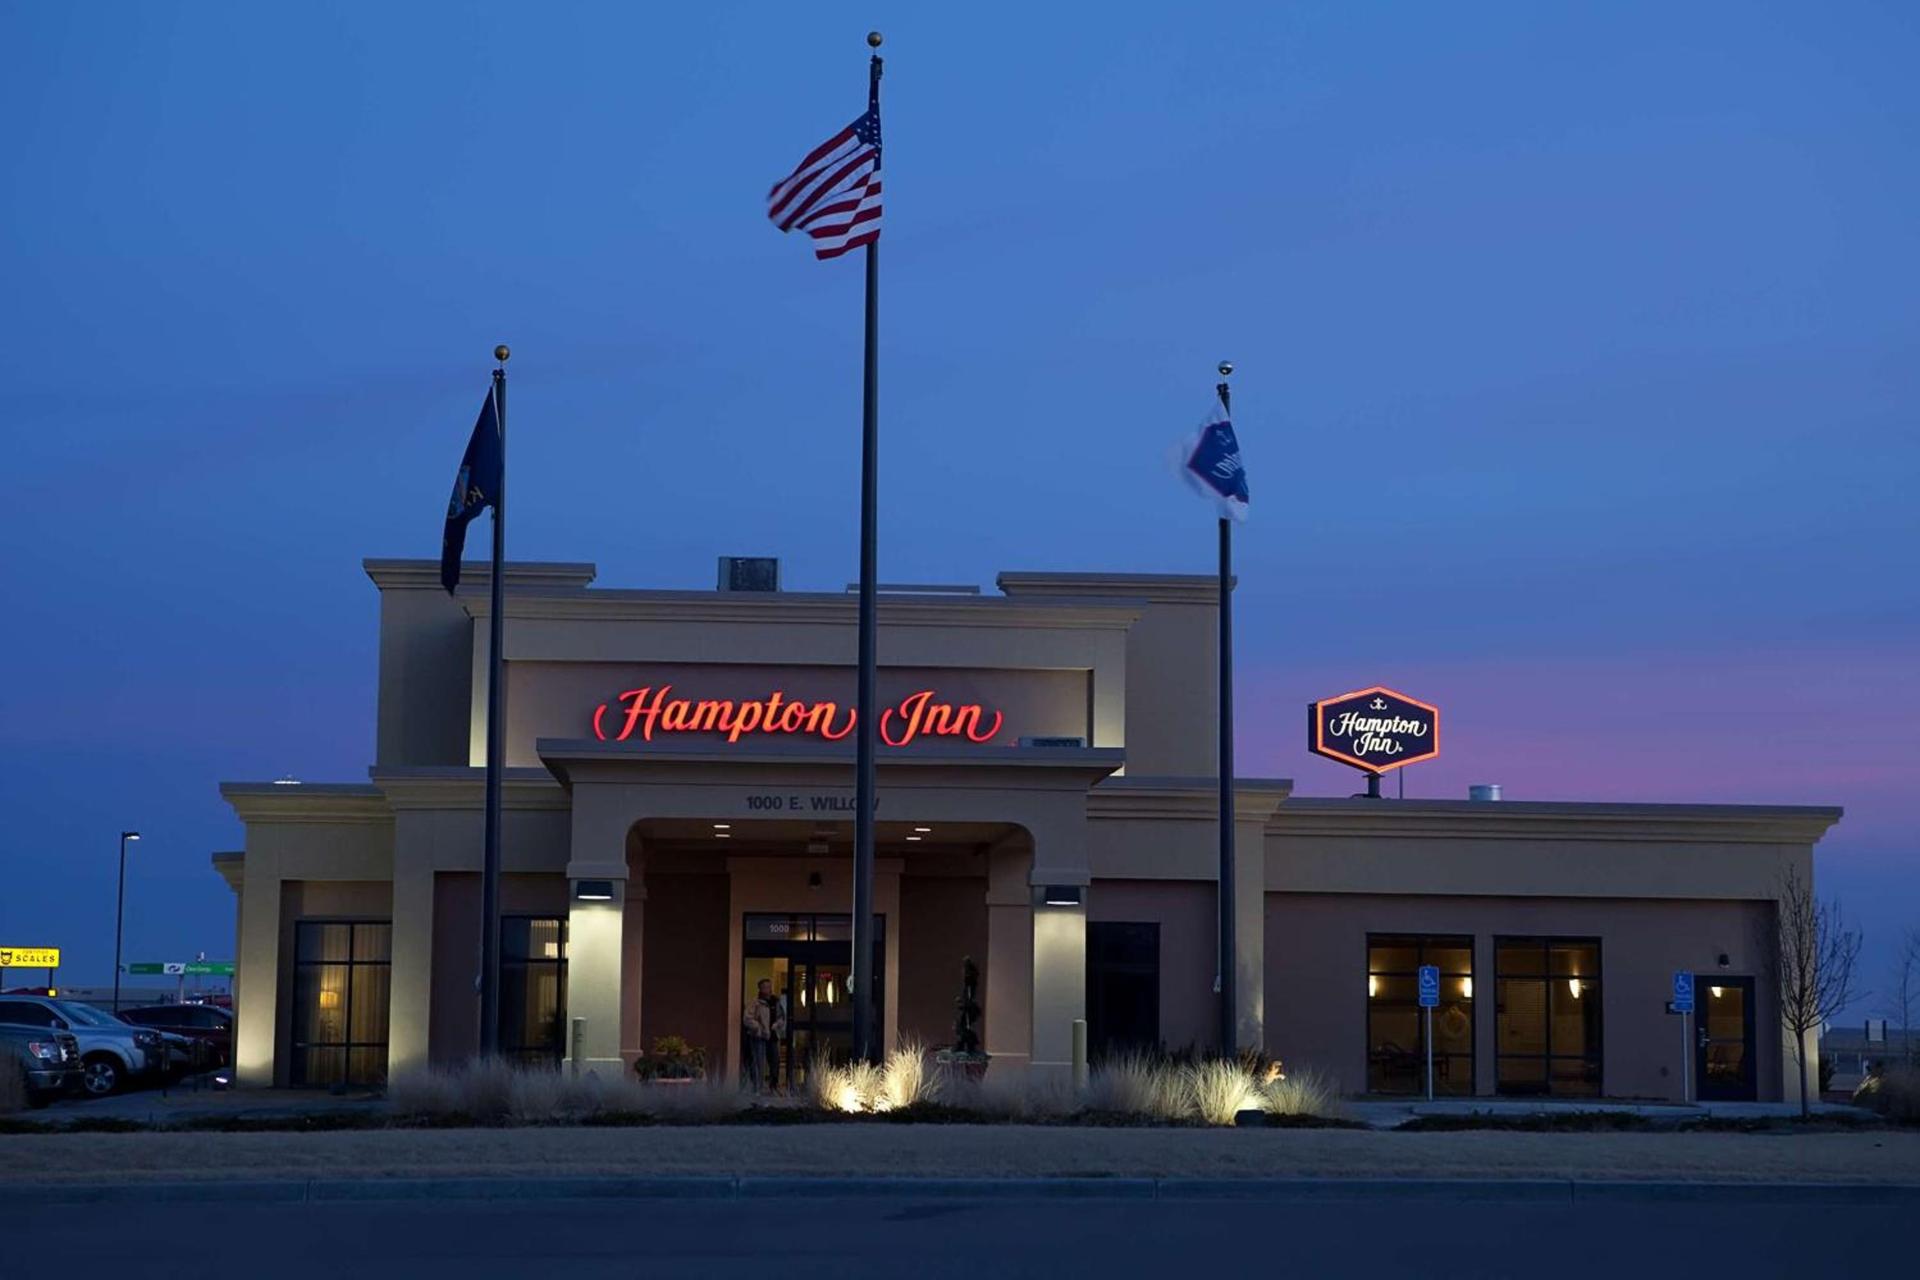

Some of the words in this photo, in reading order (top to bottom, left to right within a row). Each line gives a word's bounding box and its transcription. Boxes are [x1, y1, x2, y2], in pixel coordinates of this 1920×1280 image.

[593, 684, 857, 744] Hampton
[880, 690, 1004, 747] Inn
[1330, 711, 1427, 738] Hampton
[1353, 731, 1400, 756] Inn
[746, 796, 783, 810] 1000
[789, 797, 803, 810] E.
[15, 954, 56, 963] SCALES
